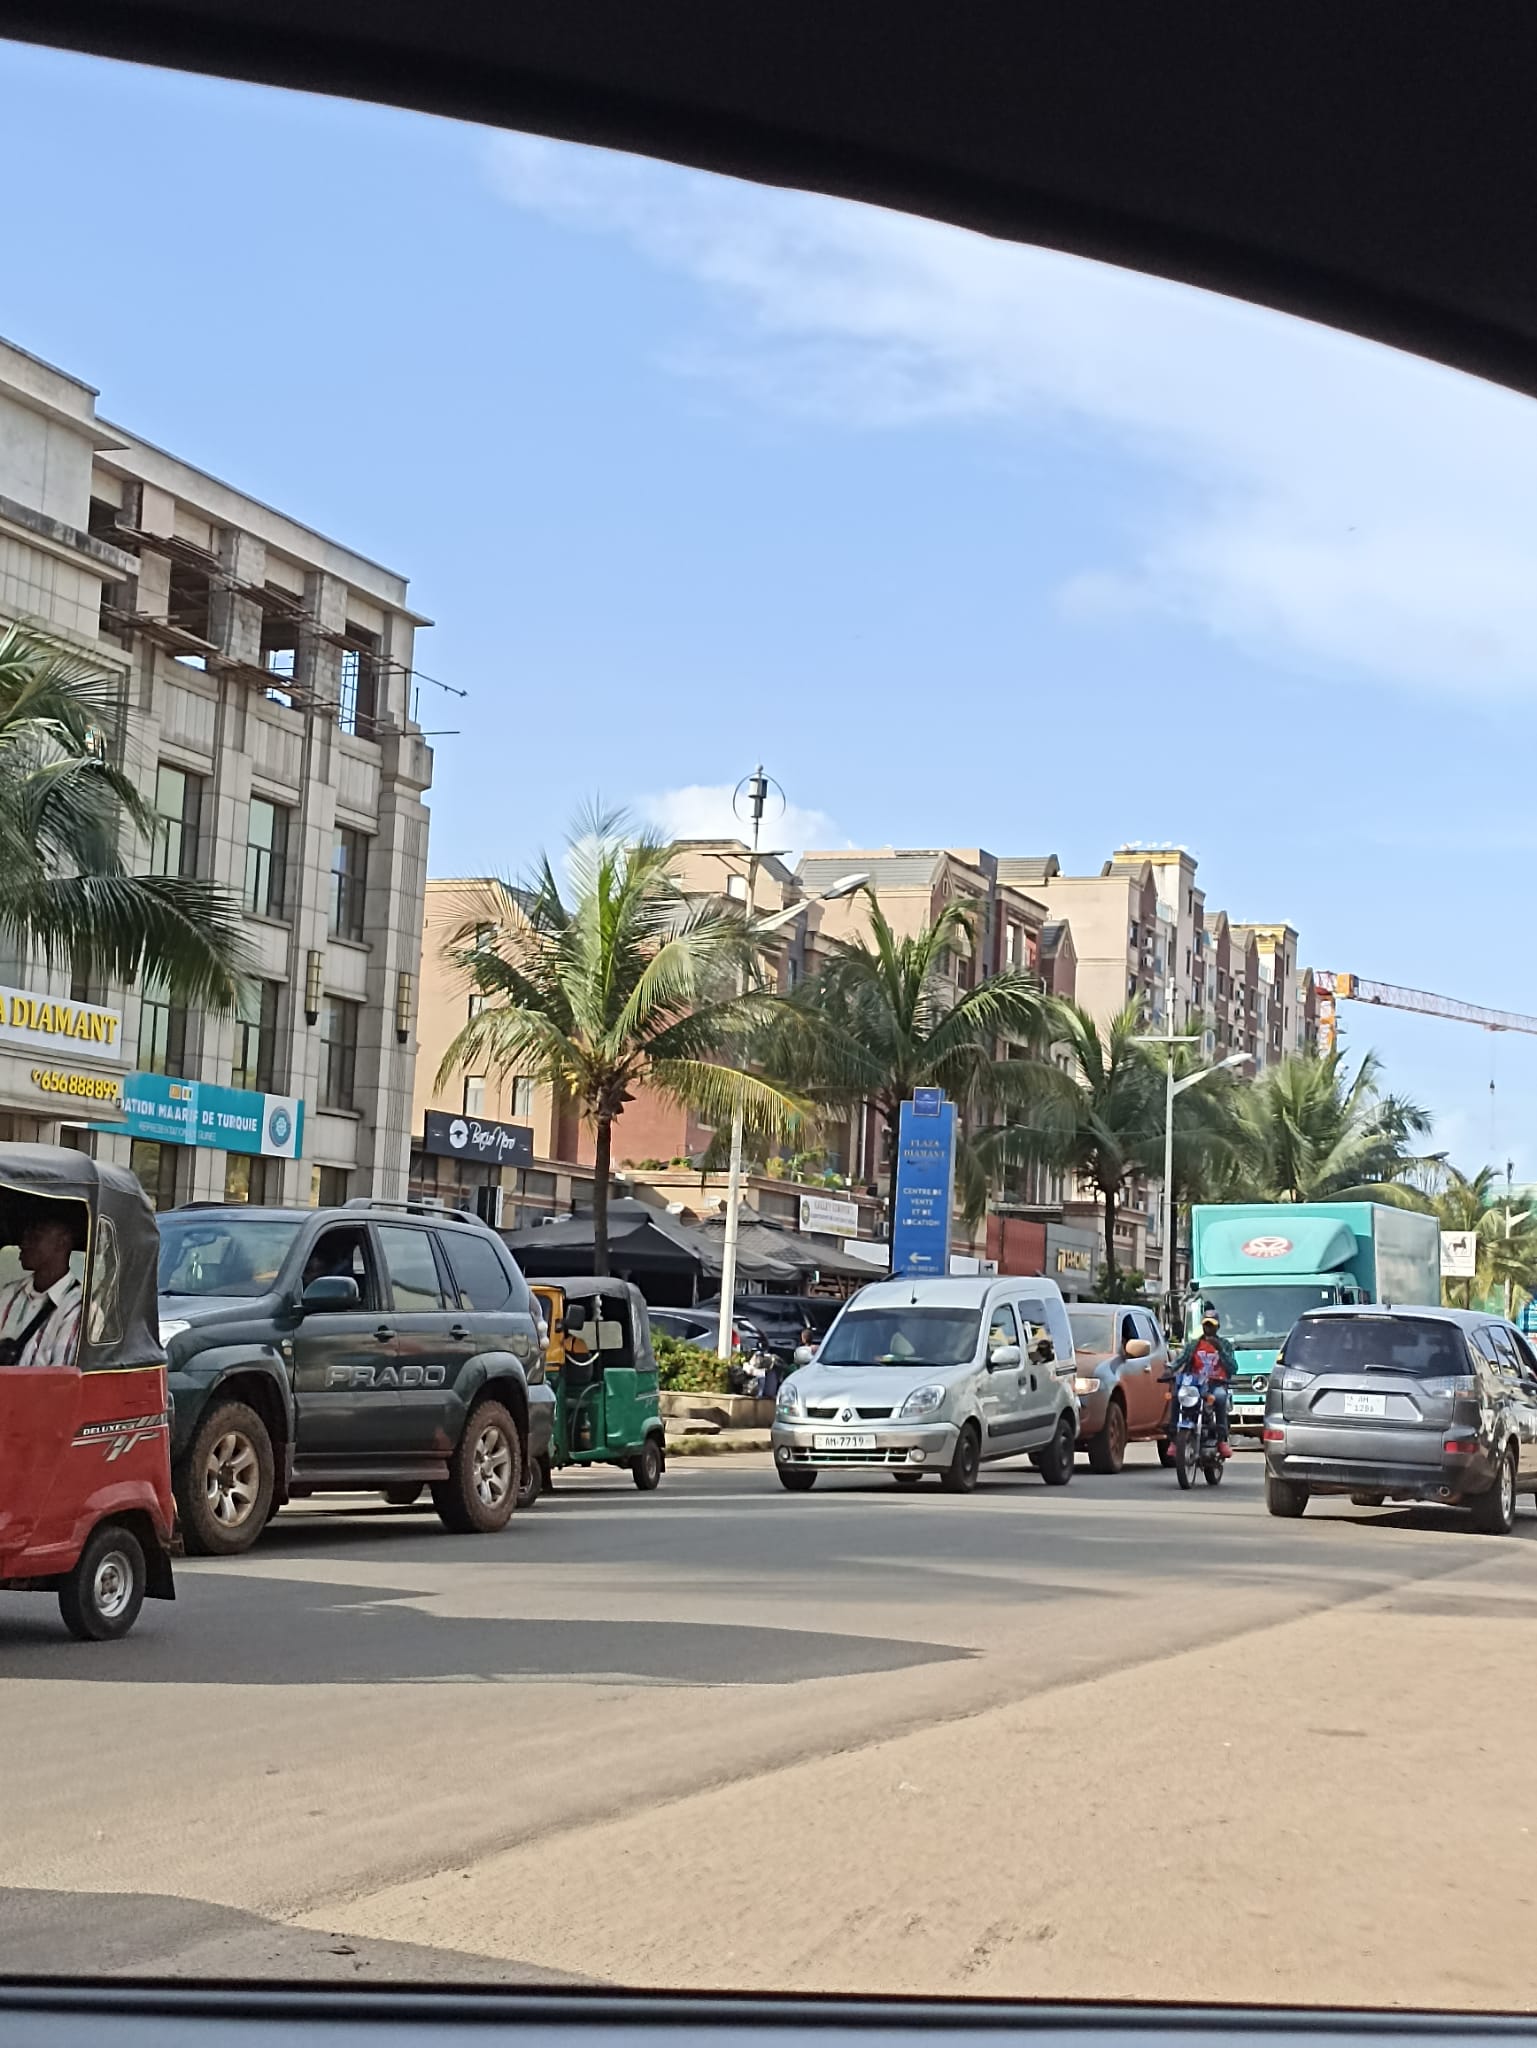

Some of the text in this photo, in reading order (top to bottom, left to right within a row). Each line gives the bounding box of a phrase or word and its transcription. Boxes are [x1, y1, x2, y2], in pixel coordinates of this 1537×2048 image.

[11, 996, 119, 1044] DIAMANT
[158, 1103, 198, 1123] MAARIF
[202, 1111, 214, 1124] DE
[217, 1113, 257, 1132] TURQUIE
[902, 1187, 931, 1196] CENTRE
[902, 1218, 940, 1227] LOCATION
[325, 1365, 446, 1388] PRADO
[82, 1423, 122, 1437] DELUXE
